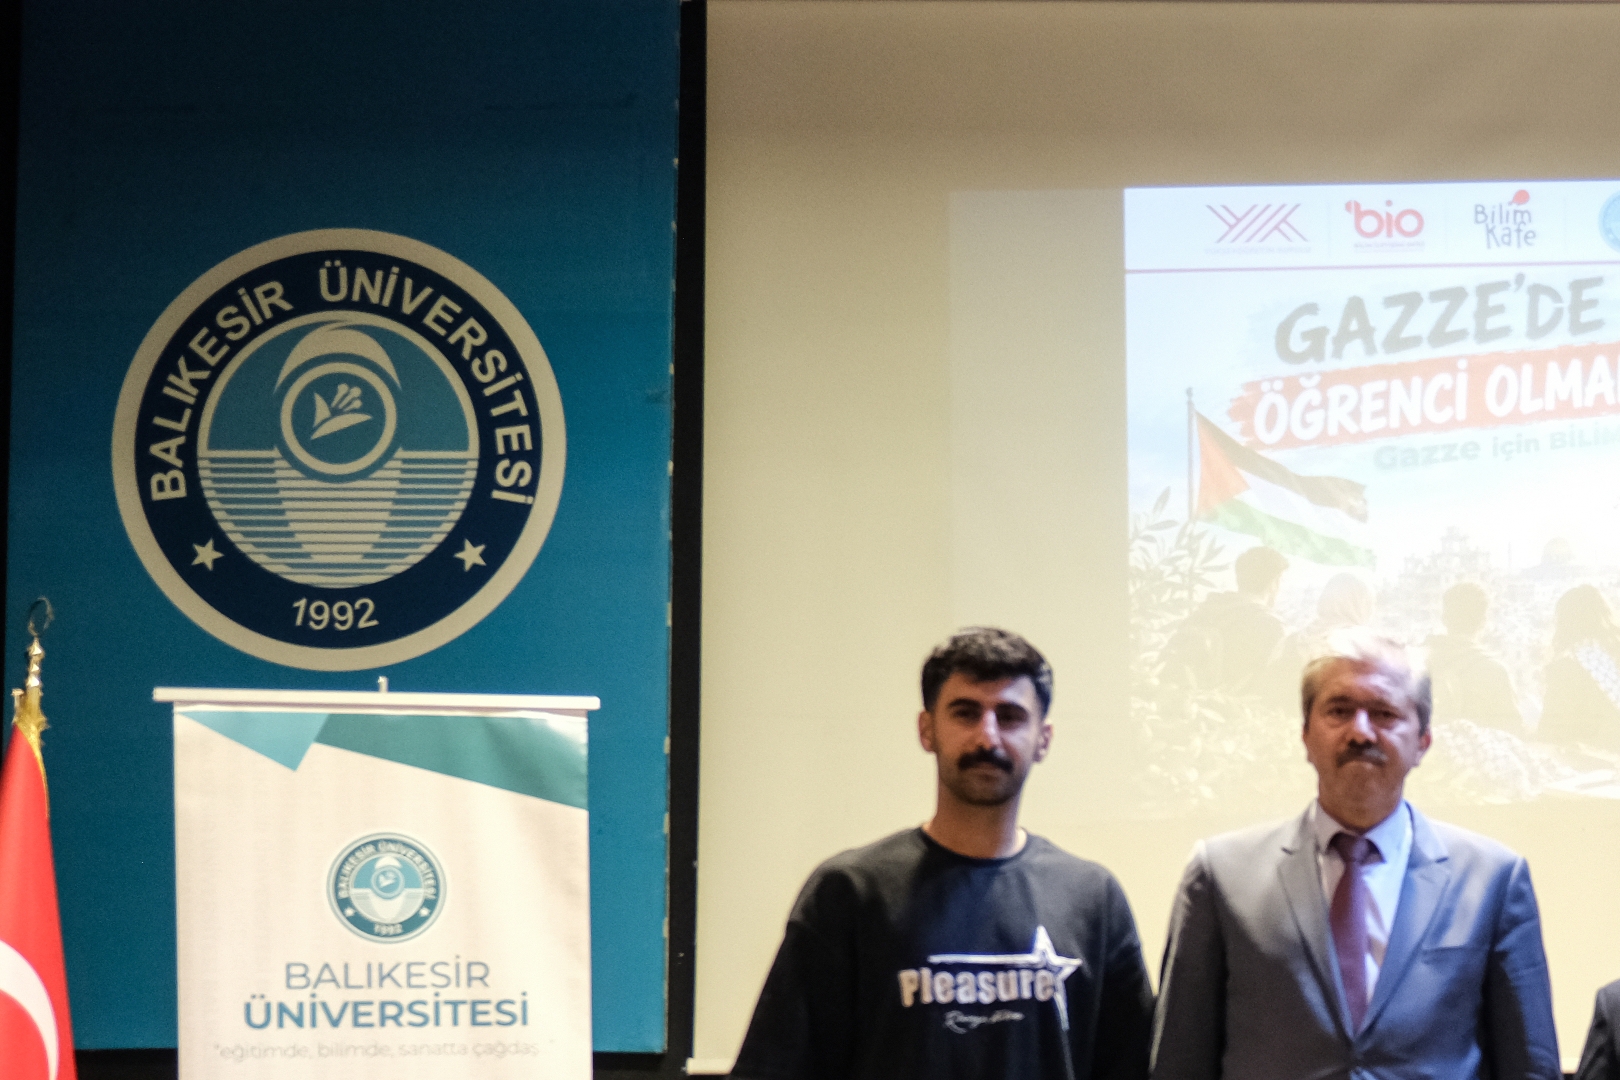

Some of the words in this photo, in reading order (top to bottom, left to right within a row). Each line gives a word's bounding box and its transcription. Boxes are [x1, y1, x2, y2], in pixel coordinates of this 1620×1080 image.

[1474, 201, 1532, 224] Bilim
[1486, 222, 1536, 249] Kafe
[149, 278, 293, 501] BALIKESİR
[319, 261, 533, 504] ÜNİVERSİTESİ
[1253, 361, 1468, 444] ÖĞRENCİ
[1373, 440, 1481, 470] Gazze
[1492, 432, 1540, 460] için
[293, 598, 379, 630] 1992
[285, 955, 490, 990] BALIKESİR
[898, 967, 1055, 1008] Pleasure
[244, 991, 528, 1029] ÜNİVERSİTESİ
[399, 1041, 467, 1057] sanatta
